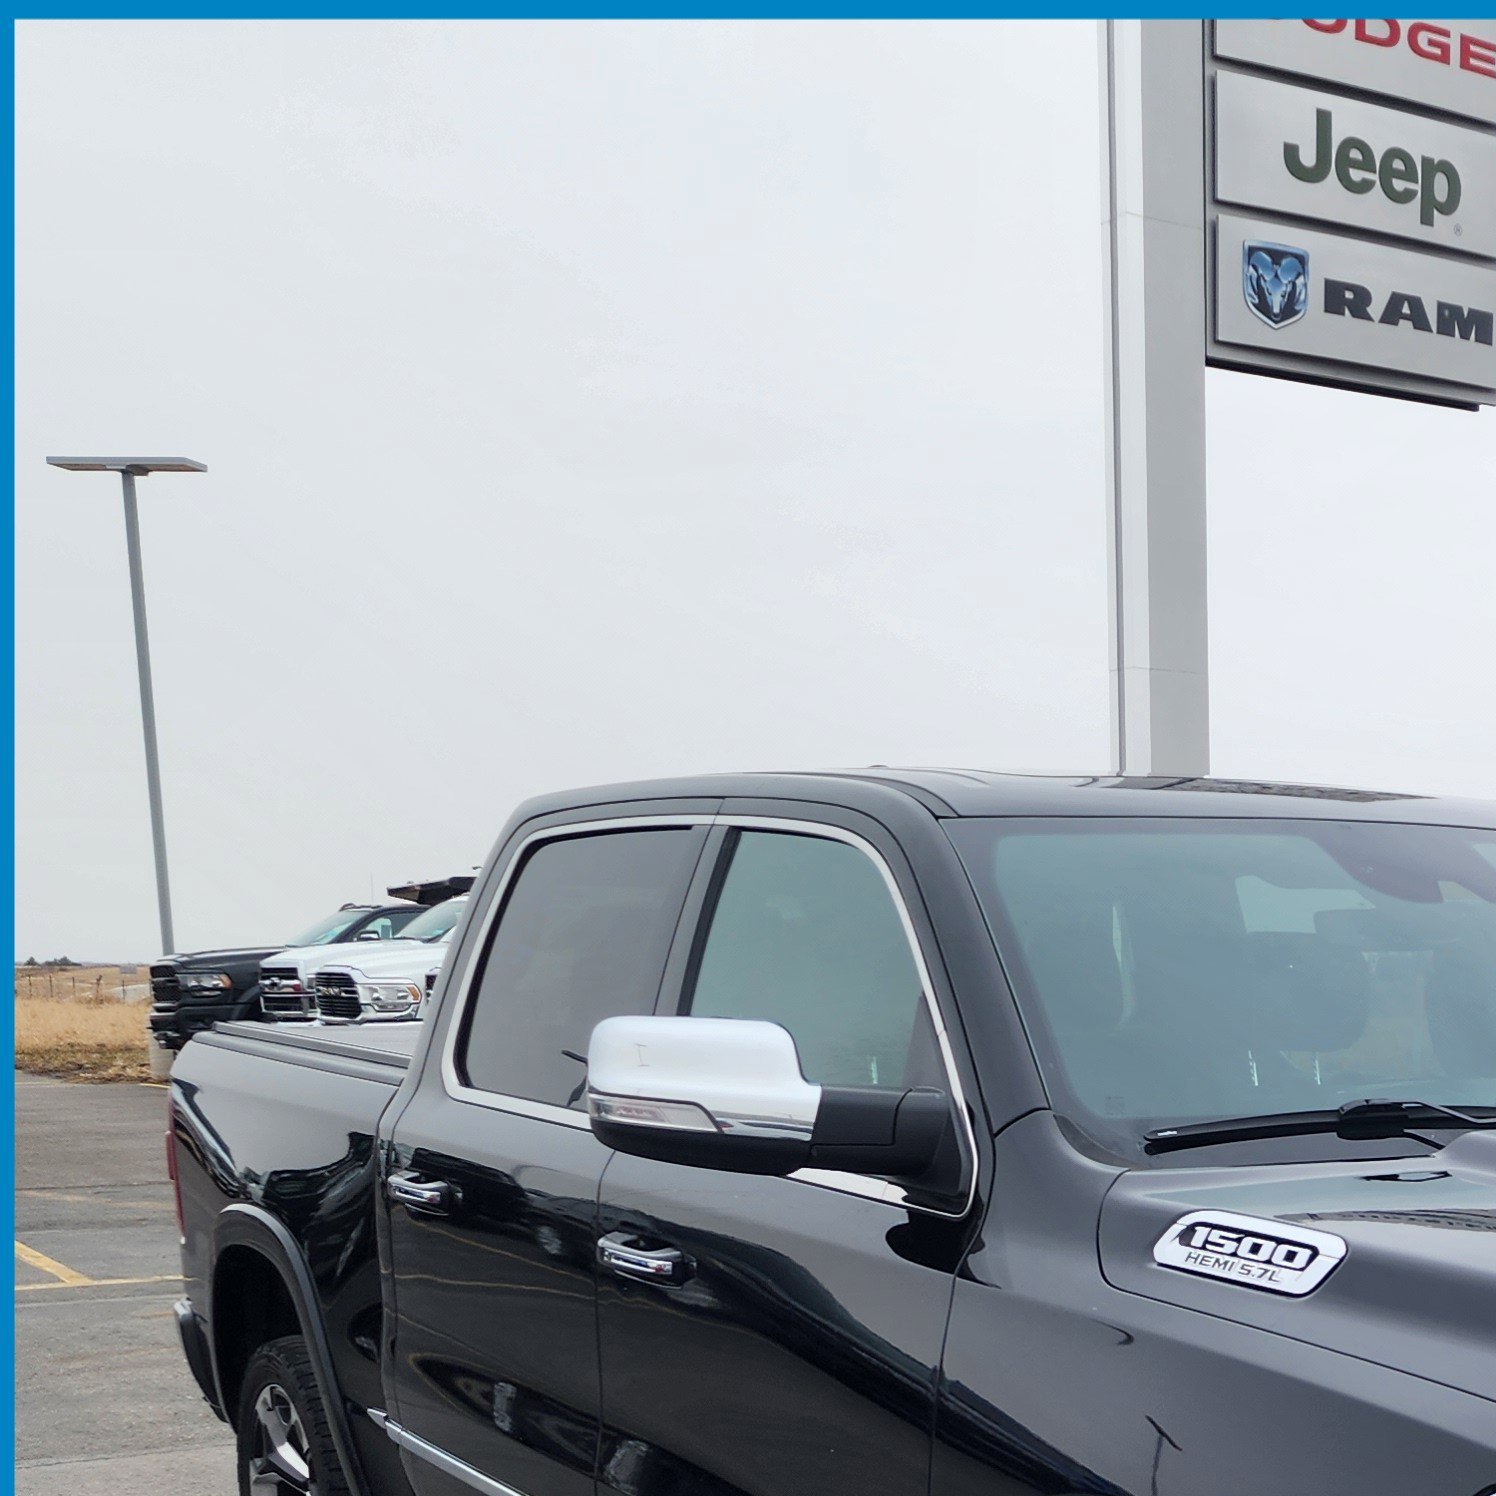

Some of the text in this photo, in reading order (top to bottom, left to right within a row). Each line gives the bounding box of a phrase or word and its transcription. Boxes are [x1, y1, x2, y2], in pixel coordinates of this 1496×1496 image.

[1283, 107, 1462, 228] Jeep
[1323, 277, 1494, 347] RAM
[1184, 1251, 1282, 1283] HEMI 5.7L
[1189, 1225, 1313, 1270] 1500
